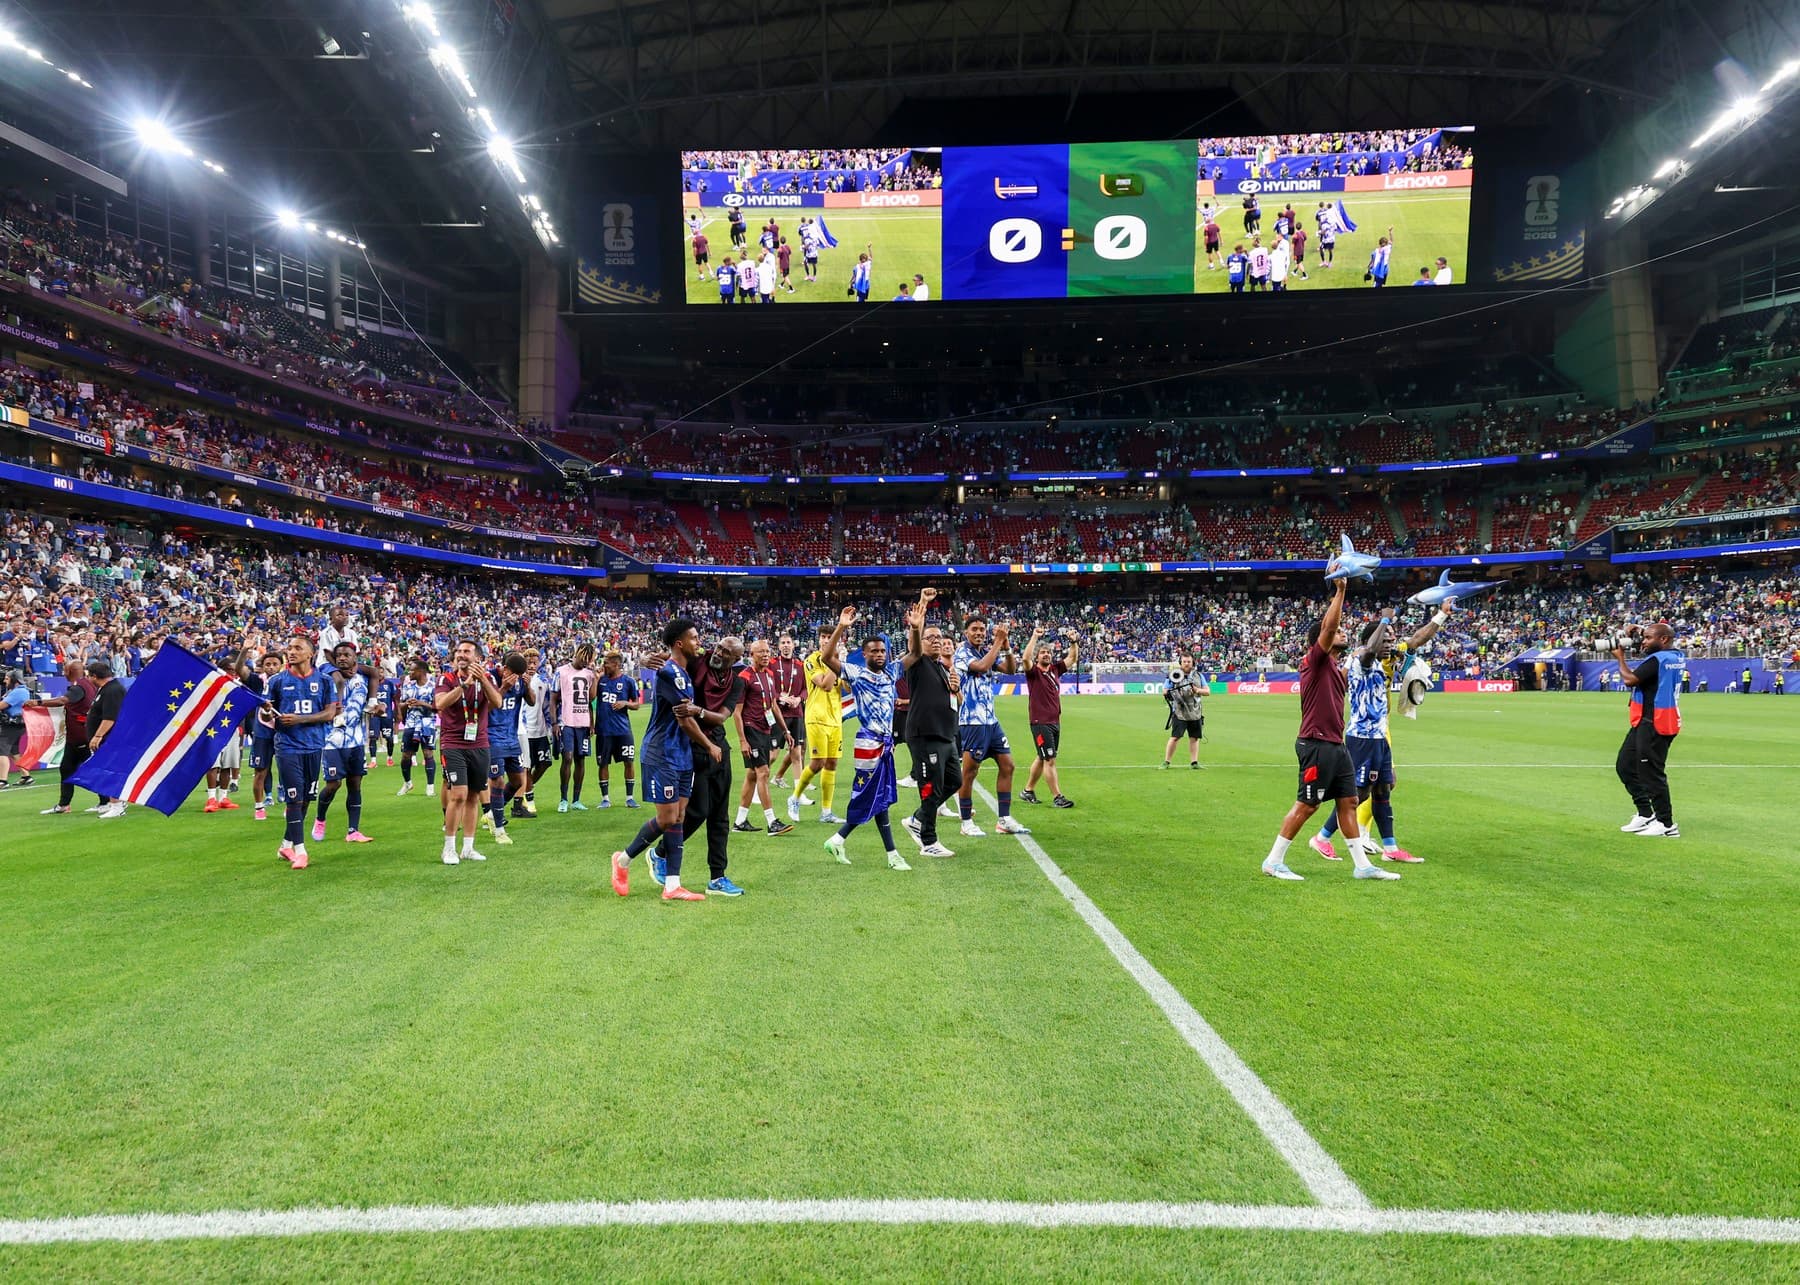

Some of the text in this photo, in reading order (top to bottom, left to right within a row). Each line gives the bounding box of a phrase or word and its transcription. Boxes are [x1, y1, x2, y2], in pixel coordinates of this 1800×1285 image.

[1263, 179, 1321, 192] HYUNDAI
[1384, 174, 1448, 189] Lenovo
[747, 195, 801, 206] HYUNDAI
[861, 193, 919, 206] Lenovo
[989, 217, 1042, 263] 0
[1094, 215, 1147, 260] 0
[1524, 231, 1557, 240] 2026
[21, 331, 35, 341] CUP
[35, 335, 59, 350] 2026
[305, 421, 340, 437] HOUSTON
[1762, 431, 1777, 440] FIFA
[74, 432, 129, 453] HOUSON
[422, 450, 432, 458] FIFA
[372, 505, 404, 518] HOUSTON
[1709, 508, 1790, 523] FIFA WORLD CUP 2026
[496, 530, 512, 538] WORLD
[502, 697, 516, 710] 15
[602, 692, 617, 703] 26
[293, 700, 312, 714] 19
[622, 745, 635, 756] 26
